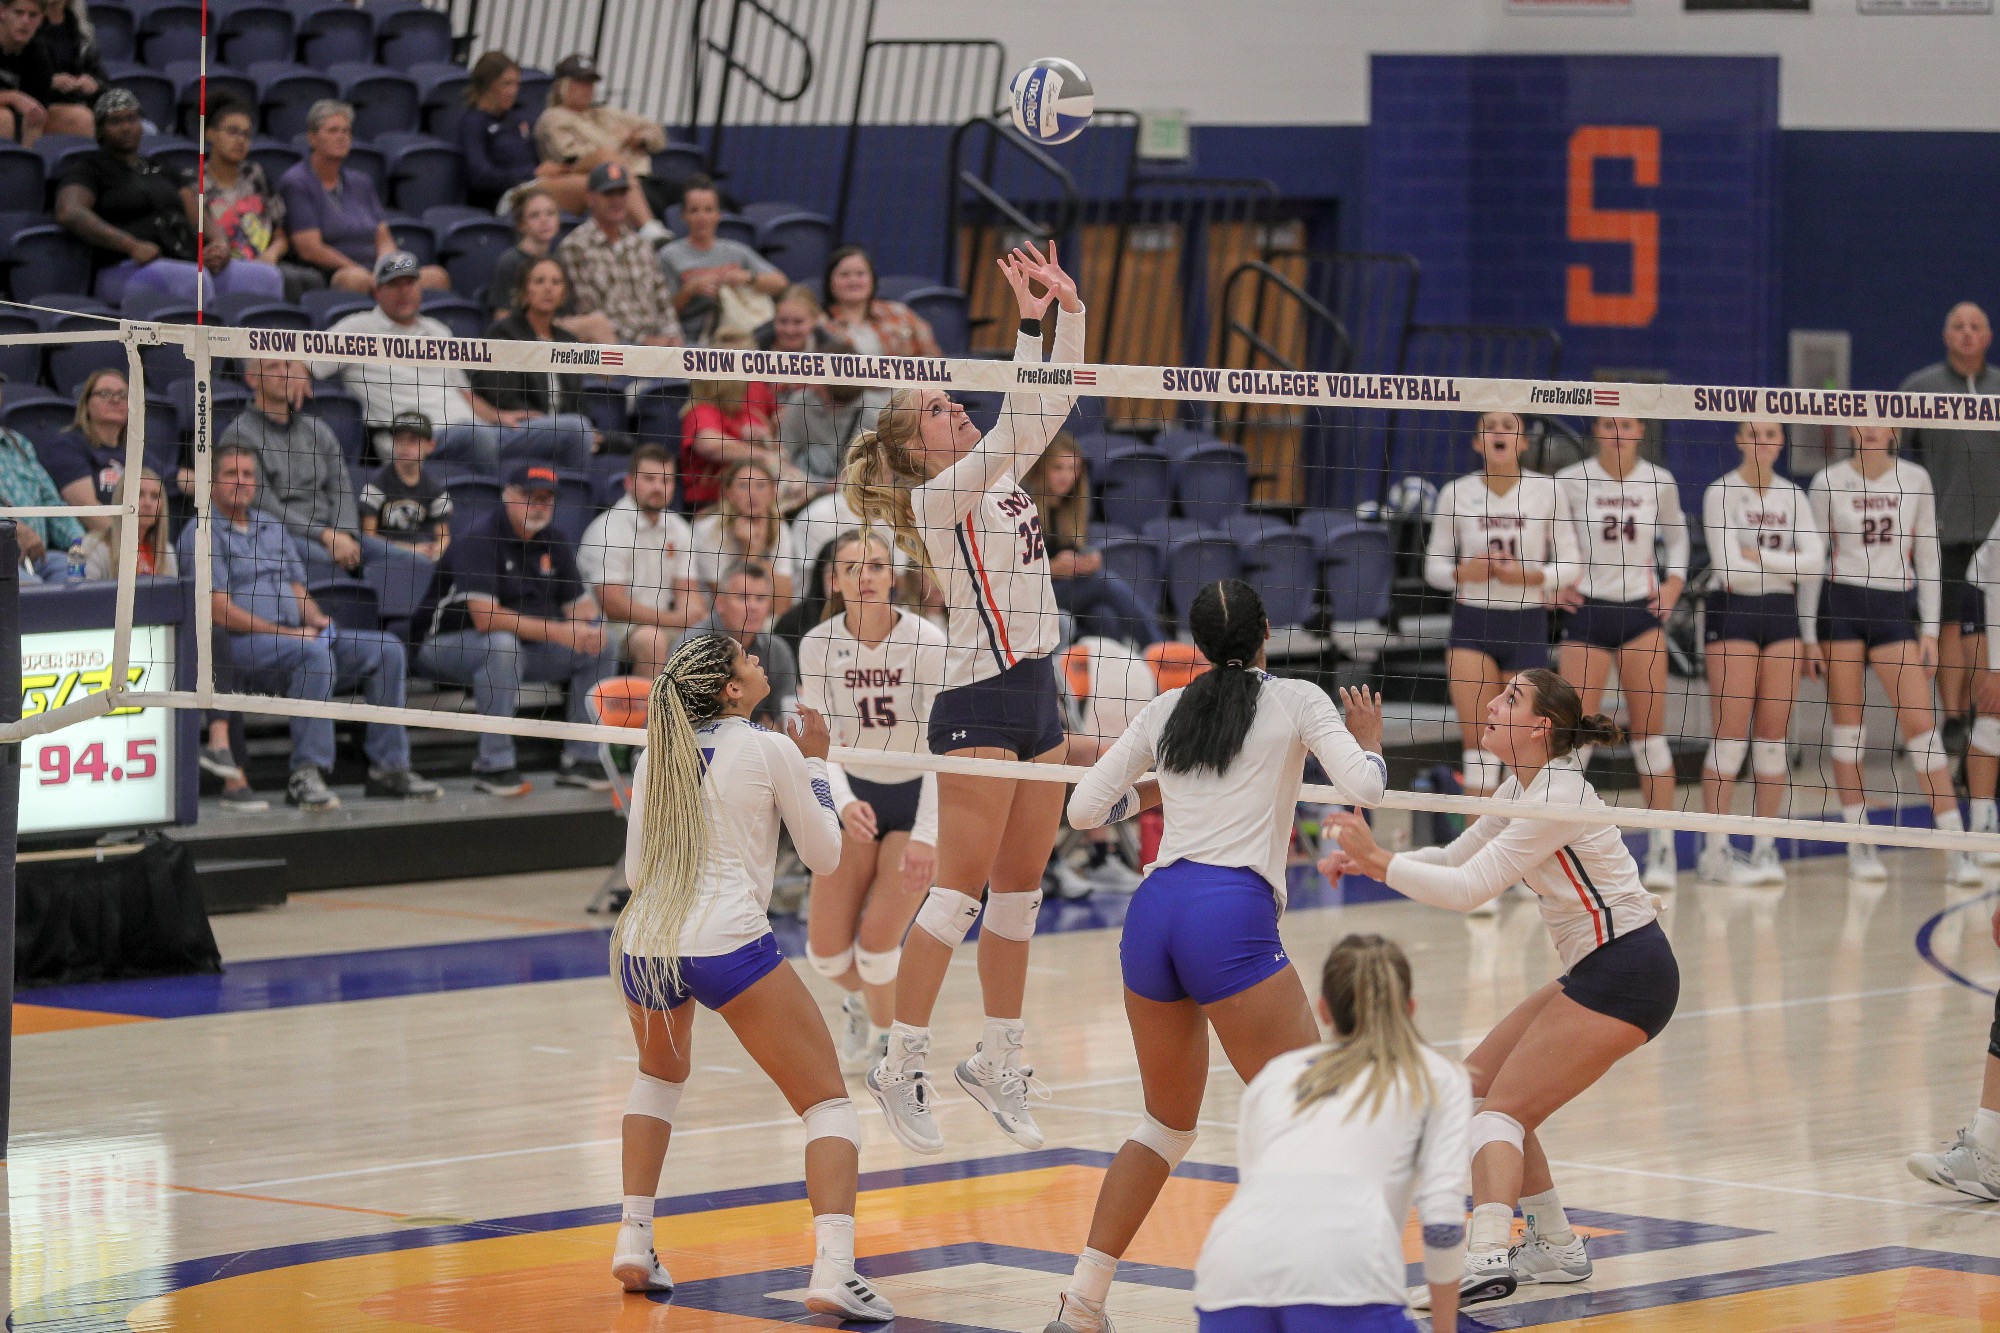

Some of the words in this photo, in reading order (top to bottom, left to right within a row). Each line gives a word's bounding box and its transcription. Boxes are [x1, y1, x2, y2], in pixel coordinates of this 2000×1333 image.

[1027, 79, 1040, 127] molten
[1566, 124, 1661, 327] S
[249, 331, 296, 353] SNOW
[303, 333, 377, 357] COLLEGE
[383, 337, 492, 363] VOLLEYBALL
[550, 348, 600, 366] FreeTaxUSA
[683, 350, 735, 373] SNOW
[742, 353, 826, 377] COLLEGE
[831, 356, 952, 383] VOLLEYBALL
[1016, 367, 1072, 386] FreeTaxUSA
[1163, 369, 1221, 394] SNOW
[1227, 371, 1319, 397] COLLEGE
[1326, 374, 1461, 402] VOLLEYBALL
[1530, 386, 1593, 406] FreeTaxUSA
[1694, 387, 1757, 413] SNOW
[1765, 390, 1868, 418] COLLEGE
[197, 395, 207, 454] Schelde
[1018, 515, 1044, 566] 32
[1602, 515, 1636, 542] 24
[1862, 517, 1894, 545] 22
[21, 652, 63, 671] UPER
[65, 649, 104, 668] HITS
[845, 668, 903, 688] SNOW
[858, 696, 897, 728] 15
[39, 739, 157, 786] 94.5
